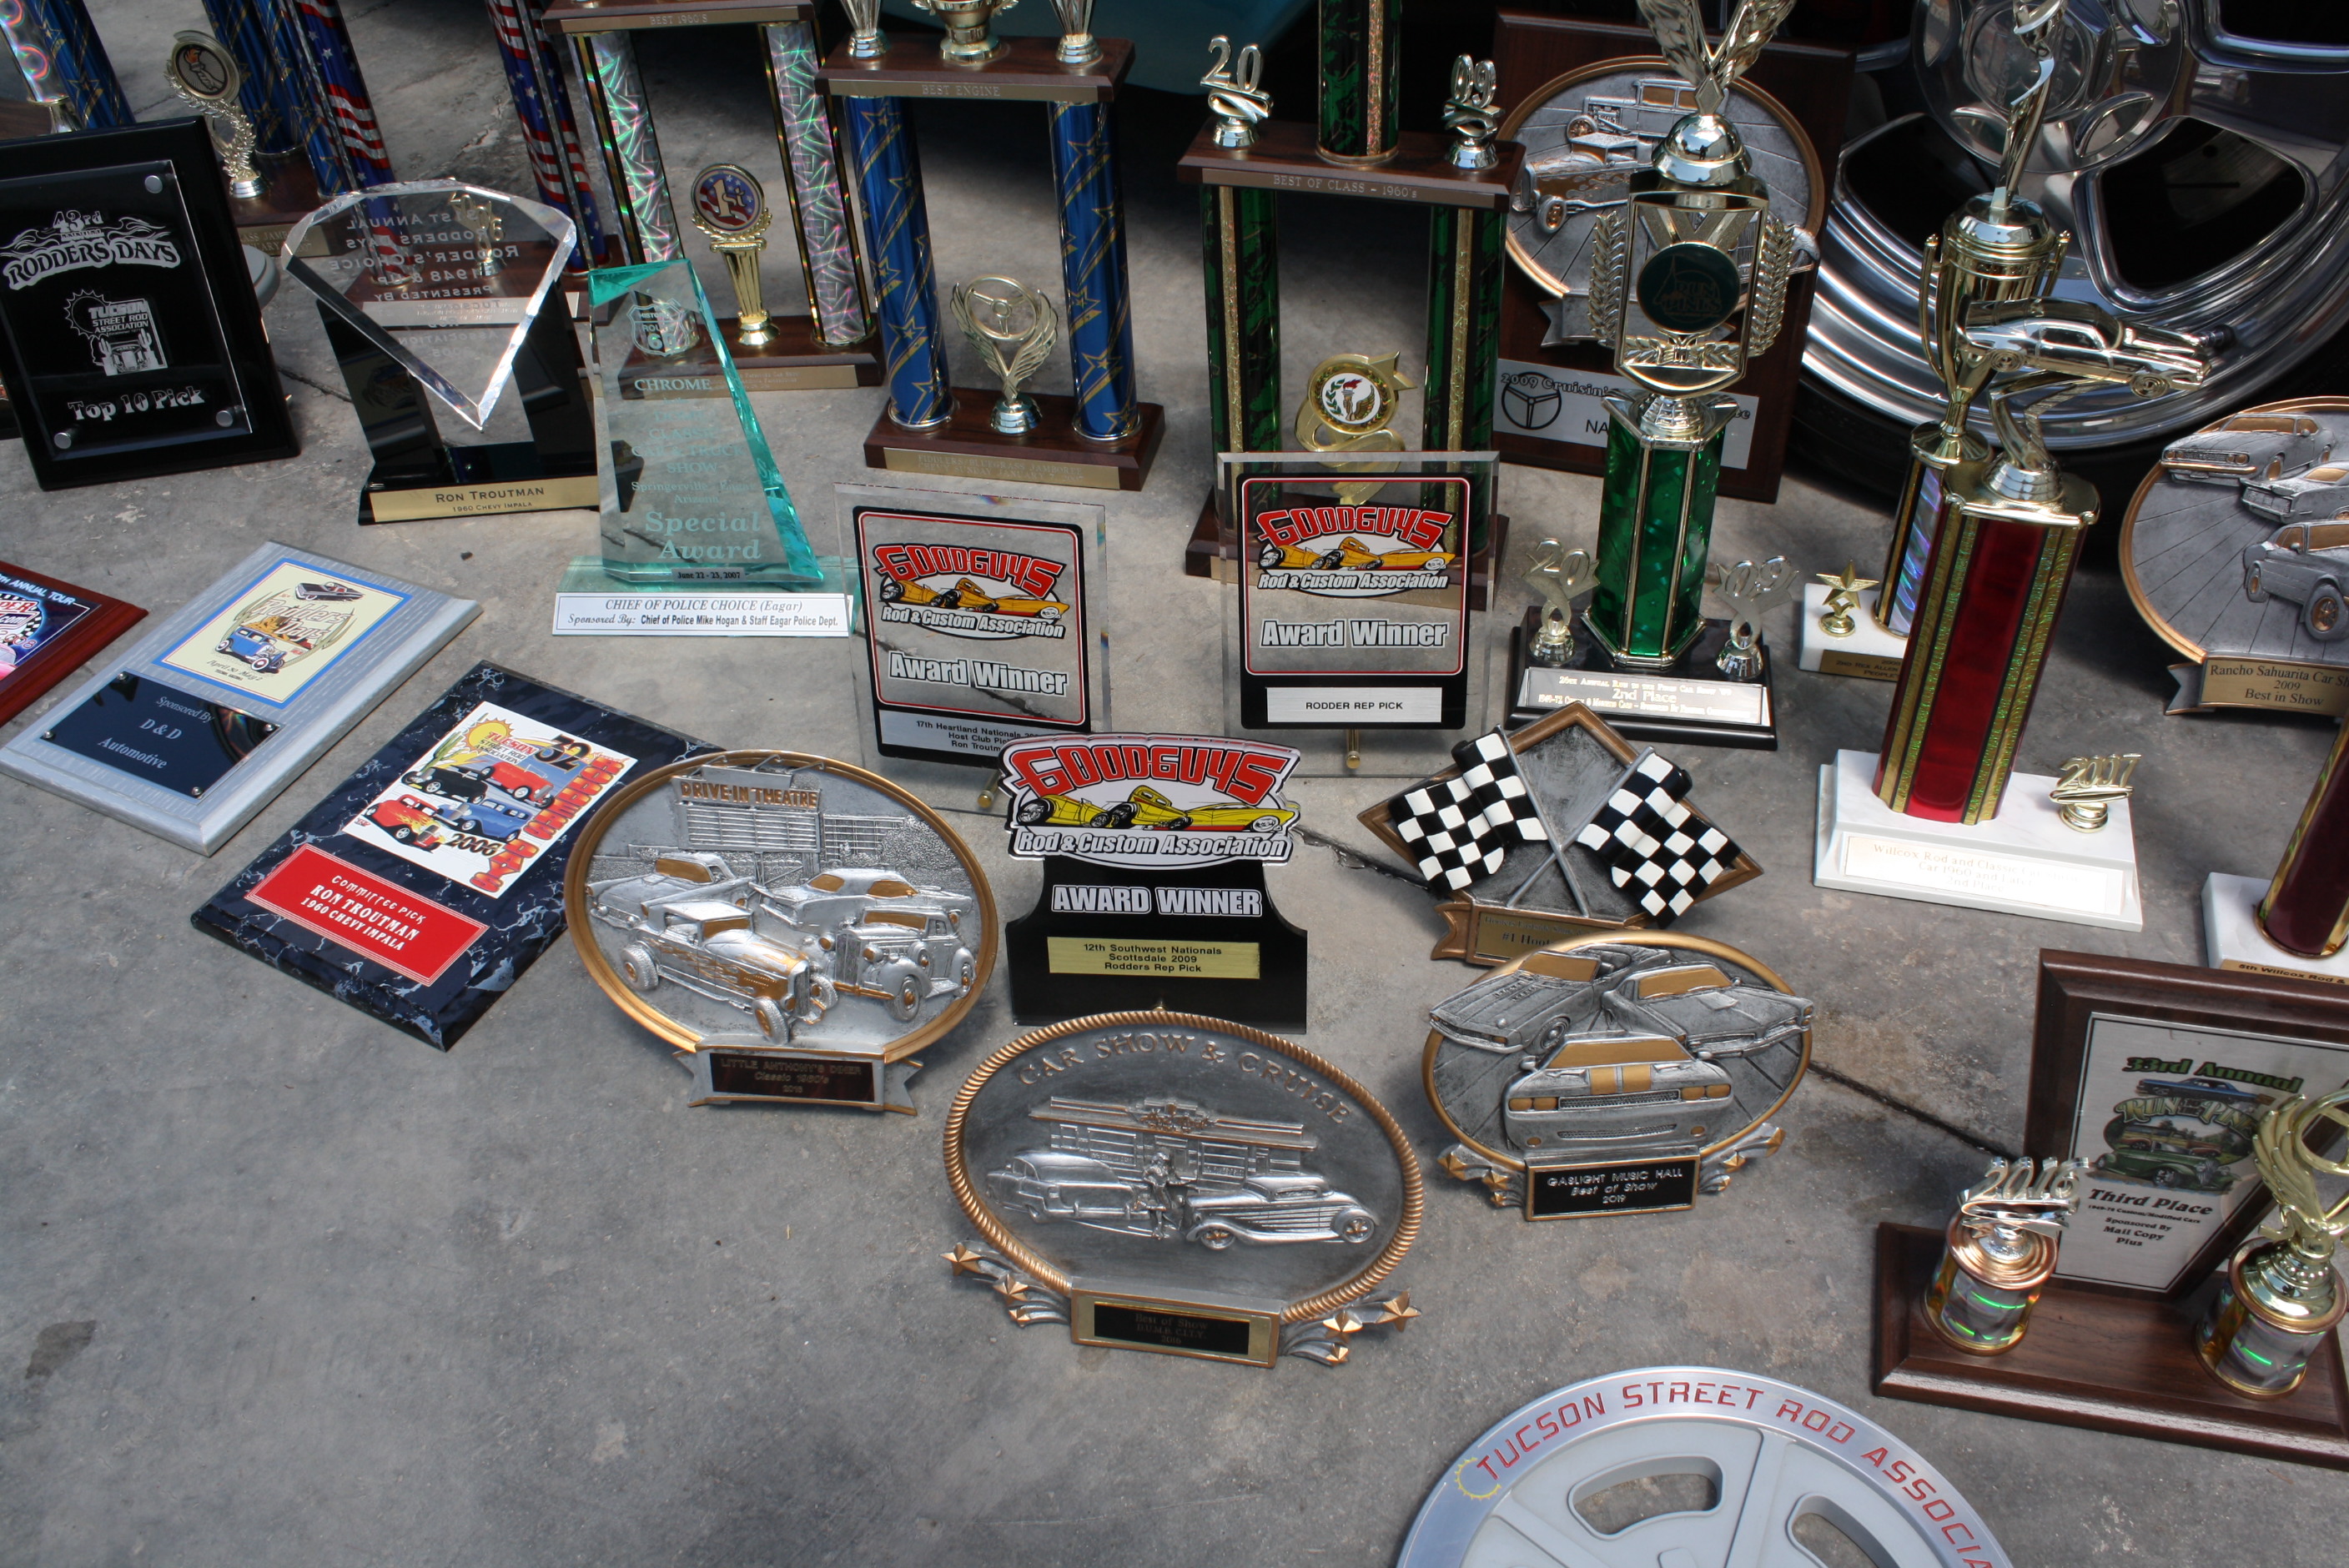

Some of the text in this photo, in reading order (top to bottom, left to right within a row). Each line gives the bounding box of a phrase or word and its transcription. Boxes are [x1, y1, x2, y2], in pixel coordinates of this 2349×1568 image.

[650, 16, 673, 25] BEST
[1200, 34, 1262, 93] 20
[922, 84, 1001, 97] BEST ENGINE
[1451, 53, 1496, 108] 09
[1274, 174, 1417, 199] BEST OF CLASS 1960's
[53, 210, 103, 233] 43rd
[5, 239, 180, 288] RODDERS DAYS
[88, 301, 148, 319] TUCSON
[93, 313, 148, 327] STREET ROD
[94, 320, 148, 334] ASSOCIATION
[634, 379, 712, 391] CHROME
[1501, 373, 1538, 389] 2009
[68, 386, 205, 421] Top 10 Pick
[667, 462, 718, 474] SHOW
[435, 493, 465, 503] RON
[646, 510, 760, 536] Special
[1255, 505, 1454, 550] GOODGUYS
[658, 539, 762, 560] Award
[677, 570, 741, 580] June 2007
[873, 543, 1067, 599] GOODGUYS
[1258, 573, 1449, 591] Rod Custom Association
[9, 580, 76, 606] ANNUAL TOUR
[252, 597, 354, 625] Rodders
[606, 600, 802, 613] CHIEF OF POLICE CHOICE (Eagar)
[567, 613, 838, 628] Sponsored By: Chief of Police Mike Hogan Staff Eagar Police Dept.
[882, 606, 1066, 638] Rod Custom Association
[1260, 618, 1449, 648] Award Winner
[888, 651, 1069, 696] Award Winner
[2211, 665, 2333, 684] Rancho Sahuarita Car
[1612, 689, 1677, 703] 2nd Place
[2274, 681, 2301, 691] 2009
[1379, 701, 1403, 710] PICK
[2246, 688, 2324, 706] Best in Show
[156, 696, 215, 724] Sponsored By
[139, 718, 182, 741] D & D
[917, 721, 933, 729] 17th
[936, 723, 978, 733] Heartland
[981, 727, 1021, 738] Nationals
[948, 732, 991, 743] Host Club
[97, 736, 168, 769] Automotive
[951, 740, 968, 748] Ron
[1010, 744, 1292, 807] GOODGUYS
[2057, 754, 2142, 788] 2007
[681, 781, 818, 809] DRIVE-IN THEATRE
[447, 832, 503, 857] 2006
[1019, 832, 1289, 858] Rod Custom Association
[1874, 844, 1974, 867] Willcox Rod and
[331, 875, 427, 925] COMMITTEE PICK
[1051, 885, 1263, 917] AWARD WINNER
[309, 884, 420, 941] RON TROUTMAN
[300, 897, 405, 951] 1960 CHEVY IMPALA
[1084, 943, 1222, 955] 12th Southwest Nationals
[1109, 954, 1197, 963] Scottsdale 2009
[1104, 963, 1149, 972] Rodders
[1154, 964, 1175, 975] Rep
[2261, 967, 2305, 978] Willcox
[2309, 974, 2333, 983] Rod
[721, 1058, 758, 1069] LITTLE
[754, 1072, 791, 1082] Classic
[1018, 1032, 1354, 1124] CAR SHOW & CRUISE
[2122, 1057, 2304, 1093] 33rd Annual
[2114, 1097, 2181, 1124] RUN
[1547, 1168, 1683, 1187] GASLIGHT MUSIC HALL
[1571, 1182, 1657, 1196] Best Show
[1602, 1194, 1627, 1204] 2019
[2089, 1189, 2213, 1215] Third Place
[2103, 1225, 2165, 1241] Mail Copy
[2105, 1217, 2156, 1229] Sponsored
[2115, 1237, 2143, 1247] Plus
[1476, 1381, 1855, 1482] TUCSON STREET ROD
